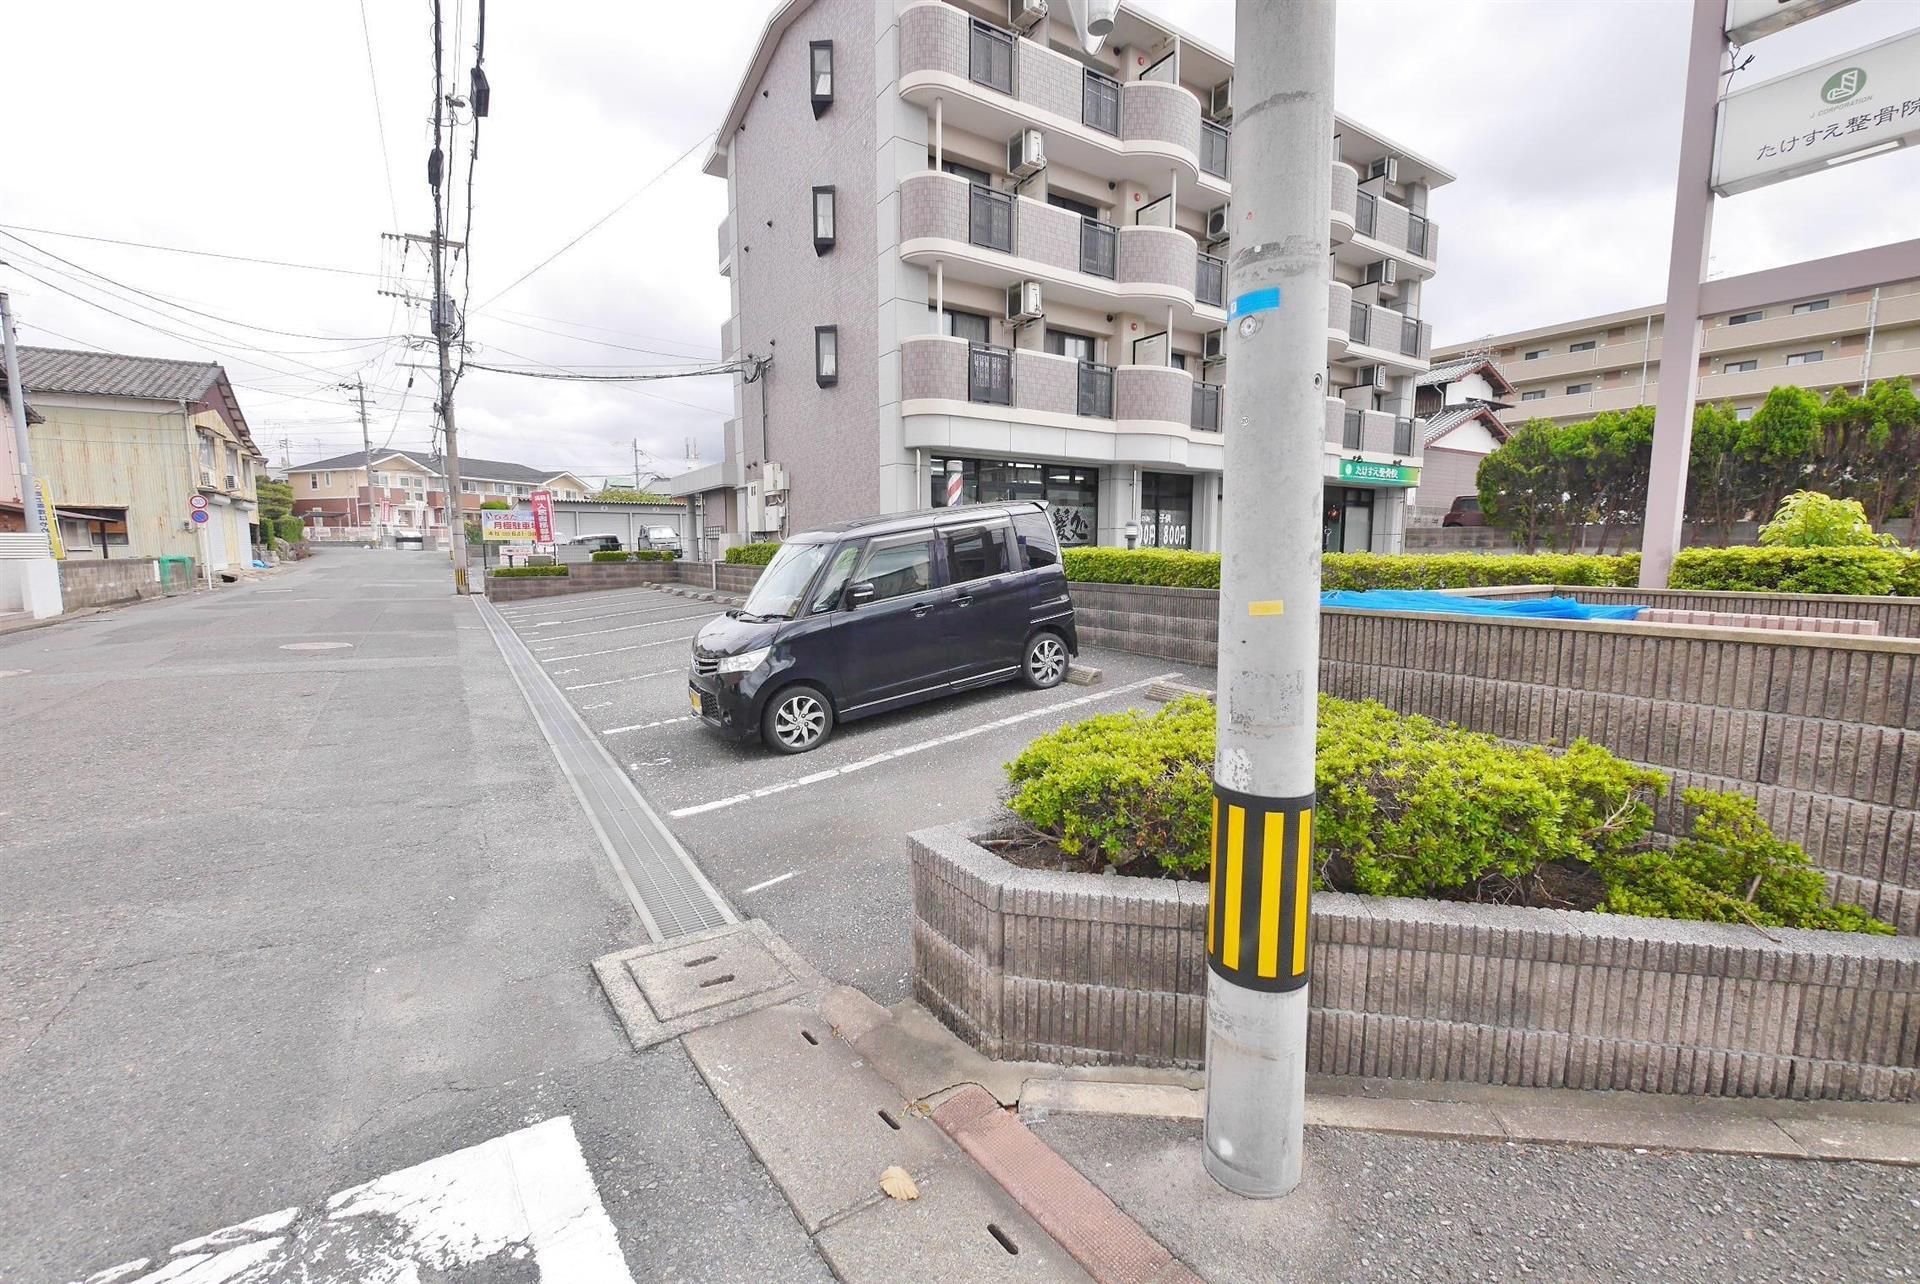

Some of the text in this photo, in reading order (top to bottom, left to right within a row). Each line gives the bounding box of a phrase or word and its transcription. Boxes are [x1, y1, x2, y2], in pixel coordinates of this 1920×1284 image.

[1817, 95, 1873, 117] CORPORATION
[1756, 98, 1920, 161] たけすえ整骨院
